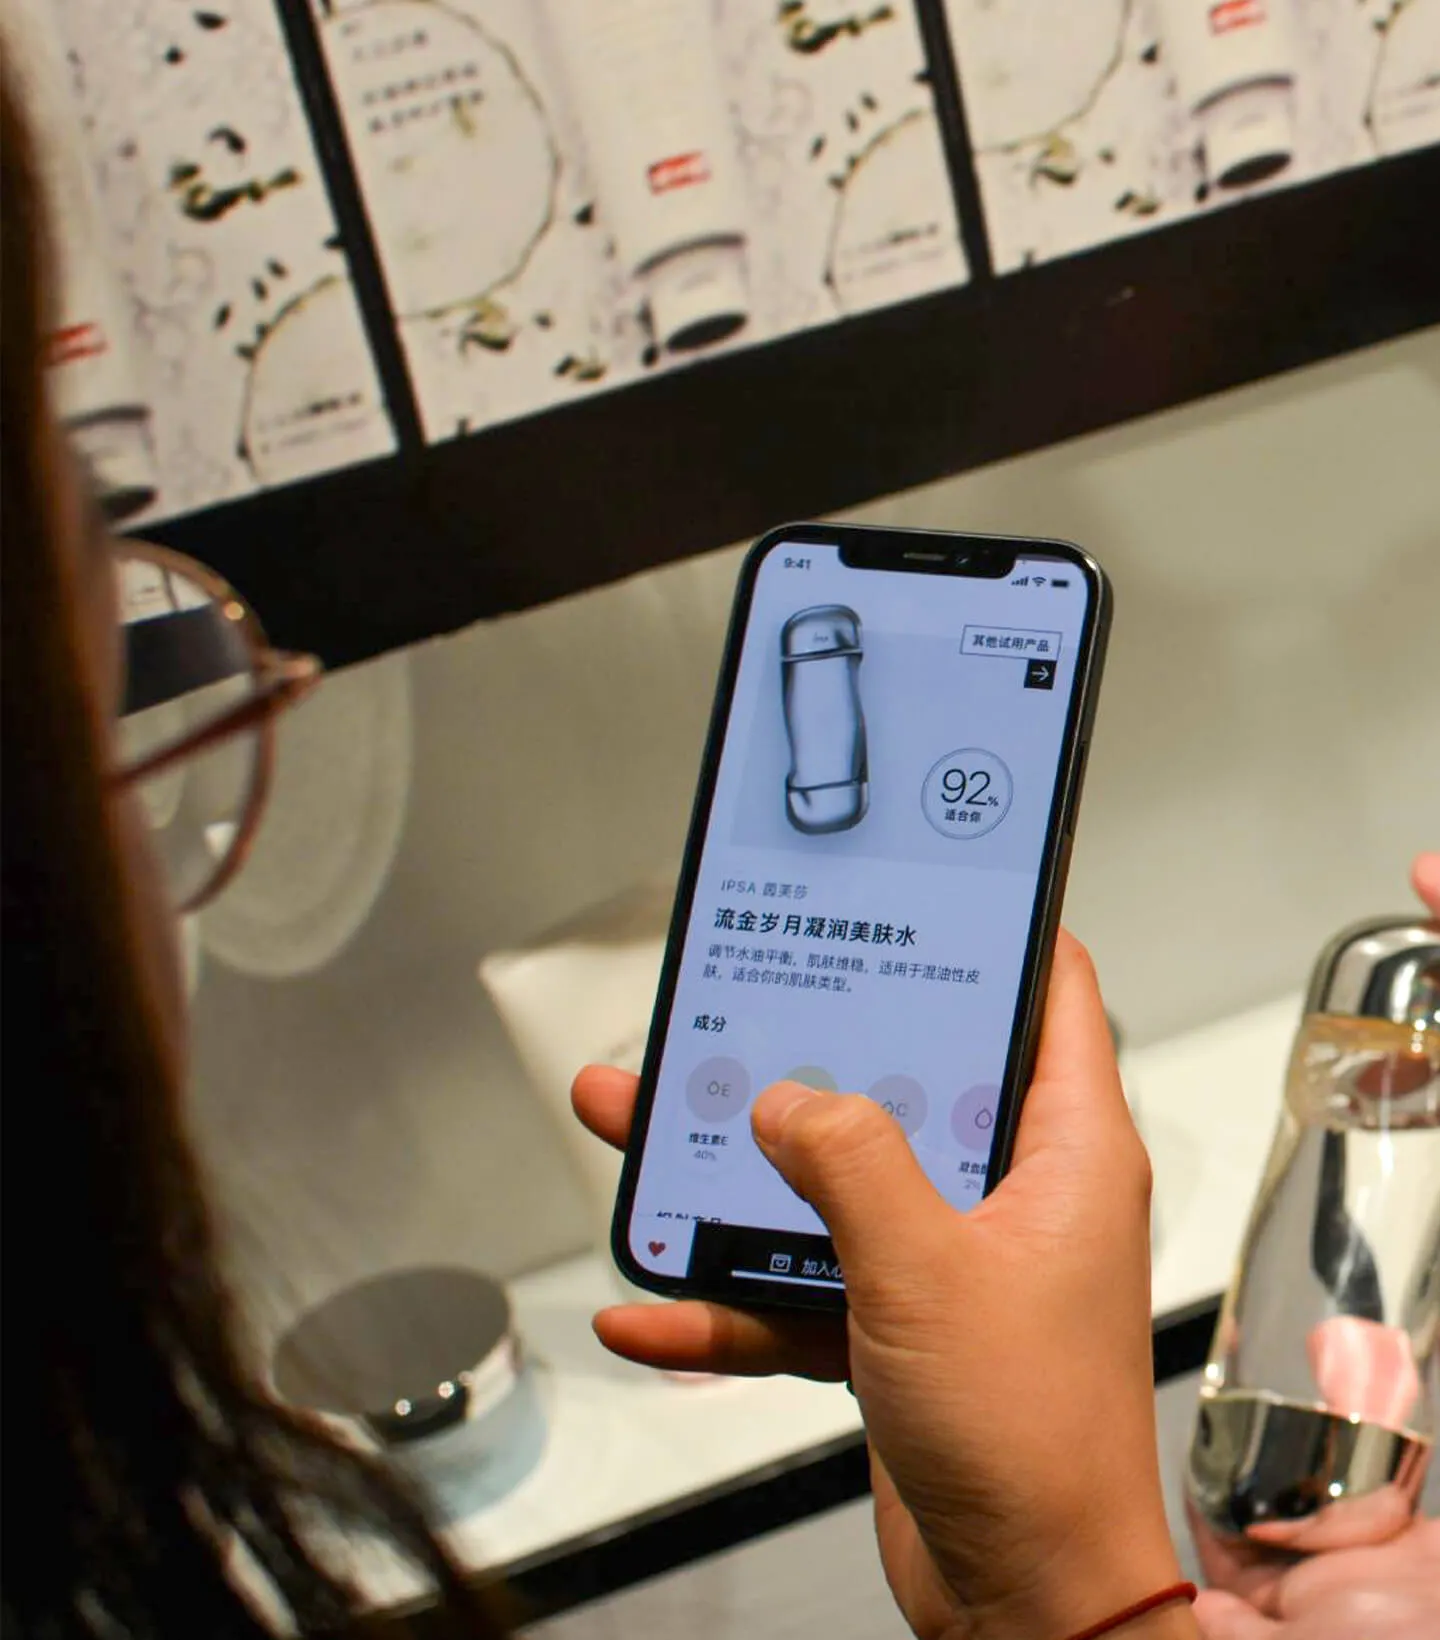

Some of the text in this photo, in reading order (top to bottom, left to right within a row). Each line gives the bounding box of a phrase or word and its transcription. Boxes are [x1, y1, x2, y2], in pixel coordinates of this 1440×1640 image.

[784, 557, 811, 570] 9:41
[973, 634, 1050, 652] 其他试用产品
[940, 768, 999, 807] 92%
[944, 809, 981, 823] 适合你
[721, 879, 756, 896] IPSA
[714, 907, 918, 947] 流金岁月凝润美肤水
[693, 1015, 727, 1033] 成分
[688, 1132, 729, 1146] 维生素E
